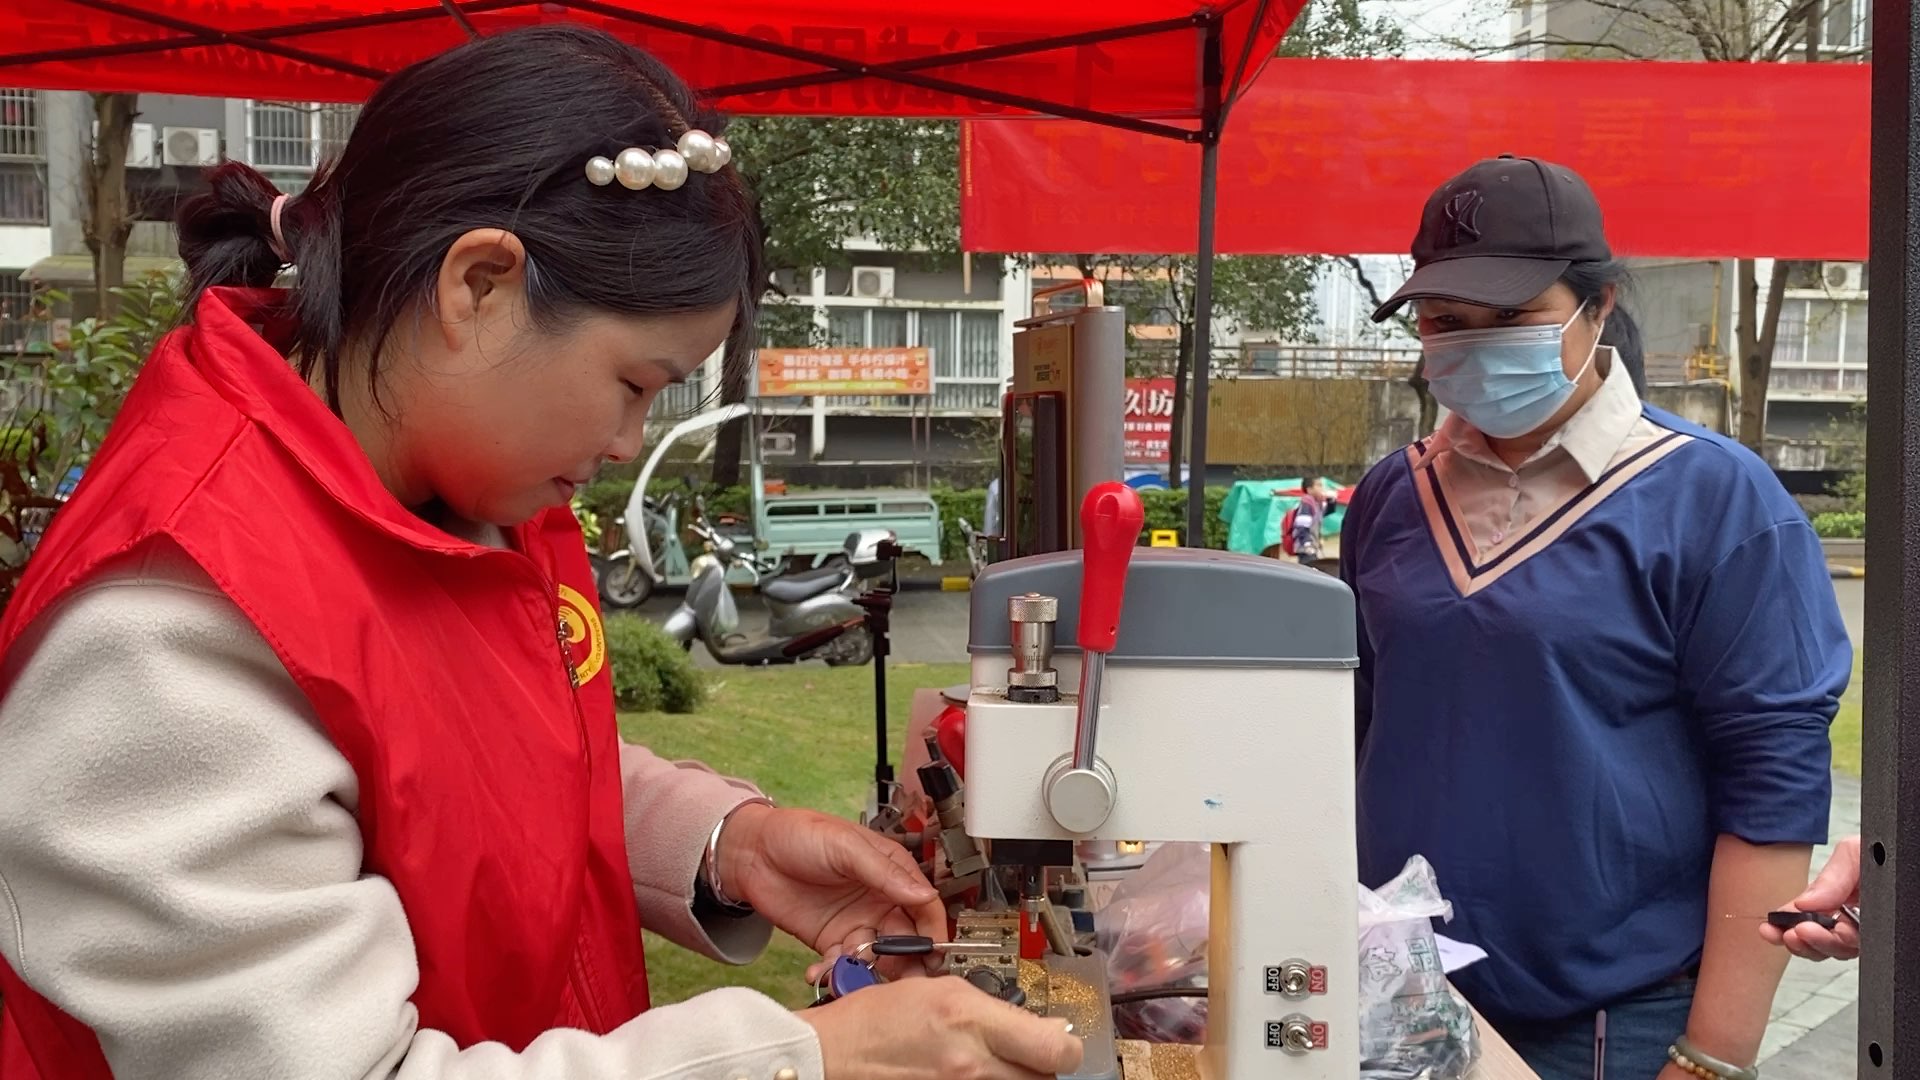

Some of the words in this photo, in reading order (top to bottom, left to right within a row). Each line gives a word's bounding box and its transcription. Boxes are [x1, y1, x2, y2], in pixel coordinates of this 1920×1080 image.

[1267, 968, 1279, 991] OFF
[1311, 969, 1324, 991] ON
[1269, 1023, 1281, 1046] OFF
[1312, 1024, 1325, 1047] ON
